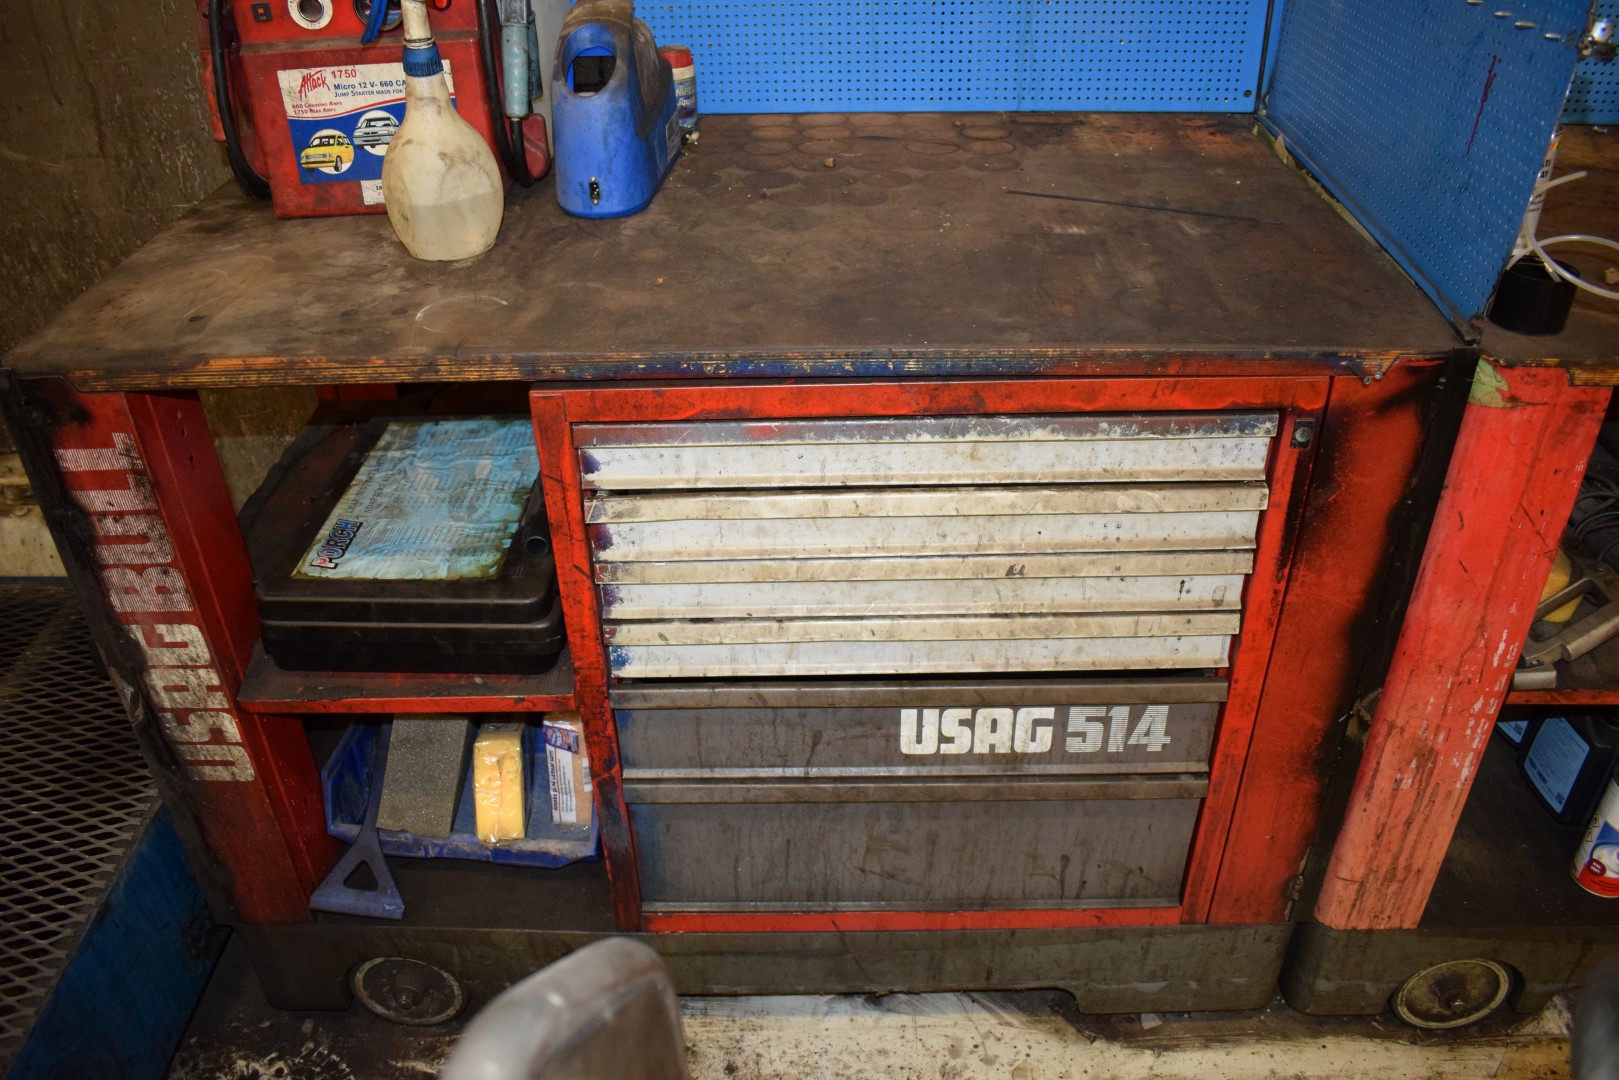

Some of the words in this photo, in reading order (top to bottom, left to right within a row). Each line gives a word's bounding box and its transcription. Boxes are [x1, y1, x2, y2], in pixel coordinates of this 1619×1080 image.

[298, 69, 330, 101] Attack
[331, 69, 357, 79] 1750
[380, 80, 393, 88] 660
[54, 432, 195, 613] BULL
[310, 519, 363, 569] PORCH
[124, 624, 255, 782] USAG
[900, 707, 1055, 755] USAG
[1066, 705, 1171, 753] 514
